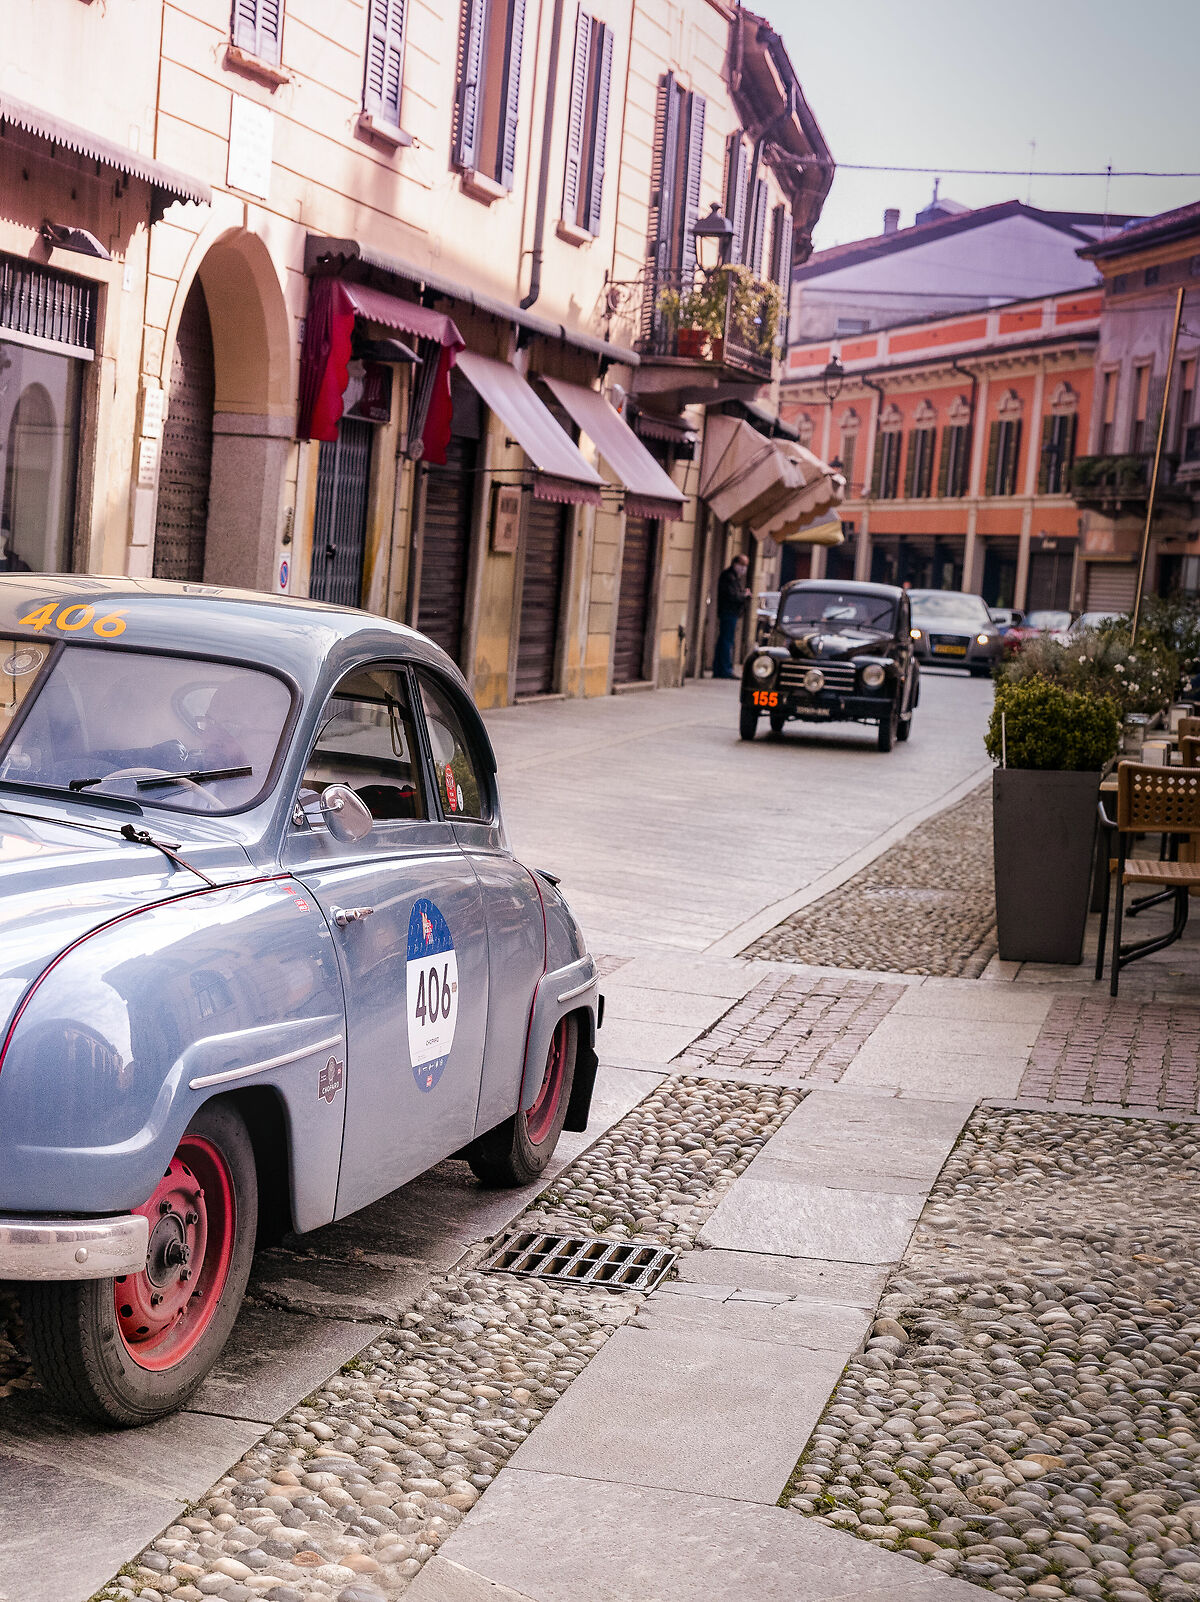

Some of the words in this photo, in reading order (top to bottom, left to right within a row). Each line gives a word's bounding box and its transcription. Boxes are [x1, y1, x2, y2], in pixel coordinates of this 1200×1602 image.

[18, 602, 131, 638] 406
[752, 690, 779, 707] 155
[415, 963, 452, 1027] 406
